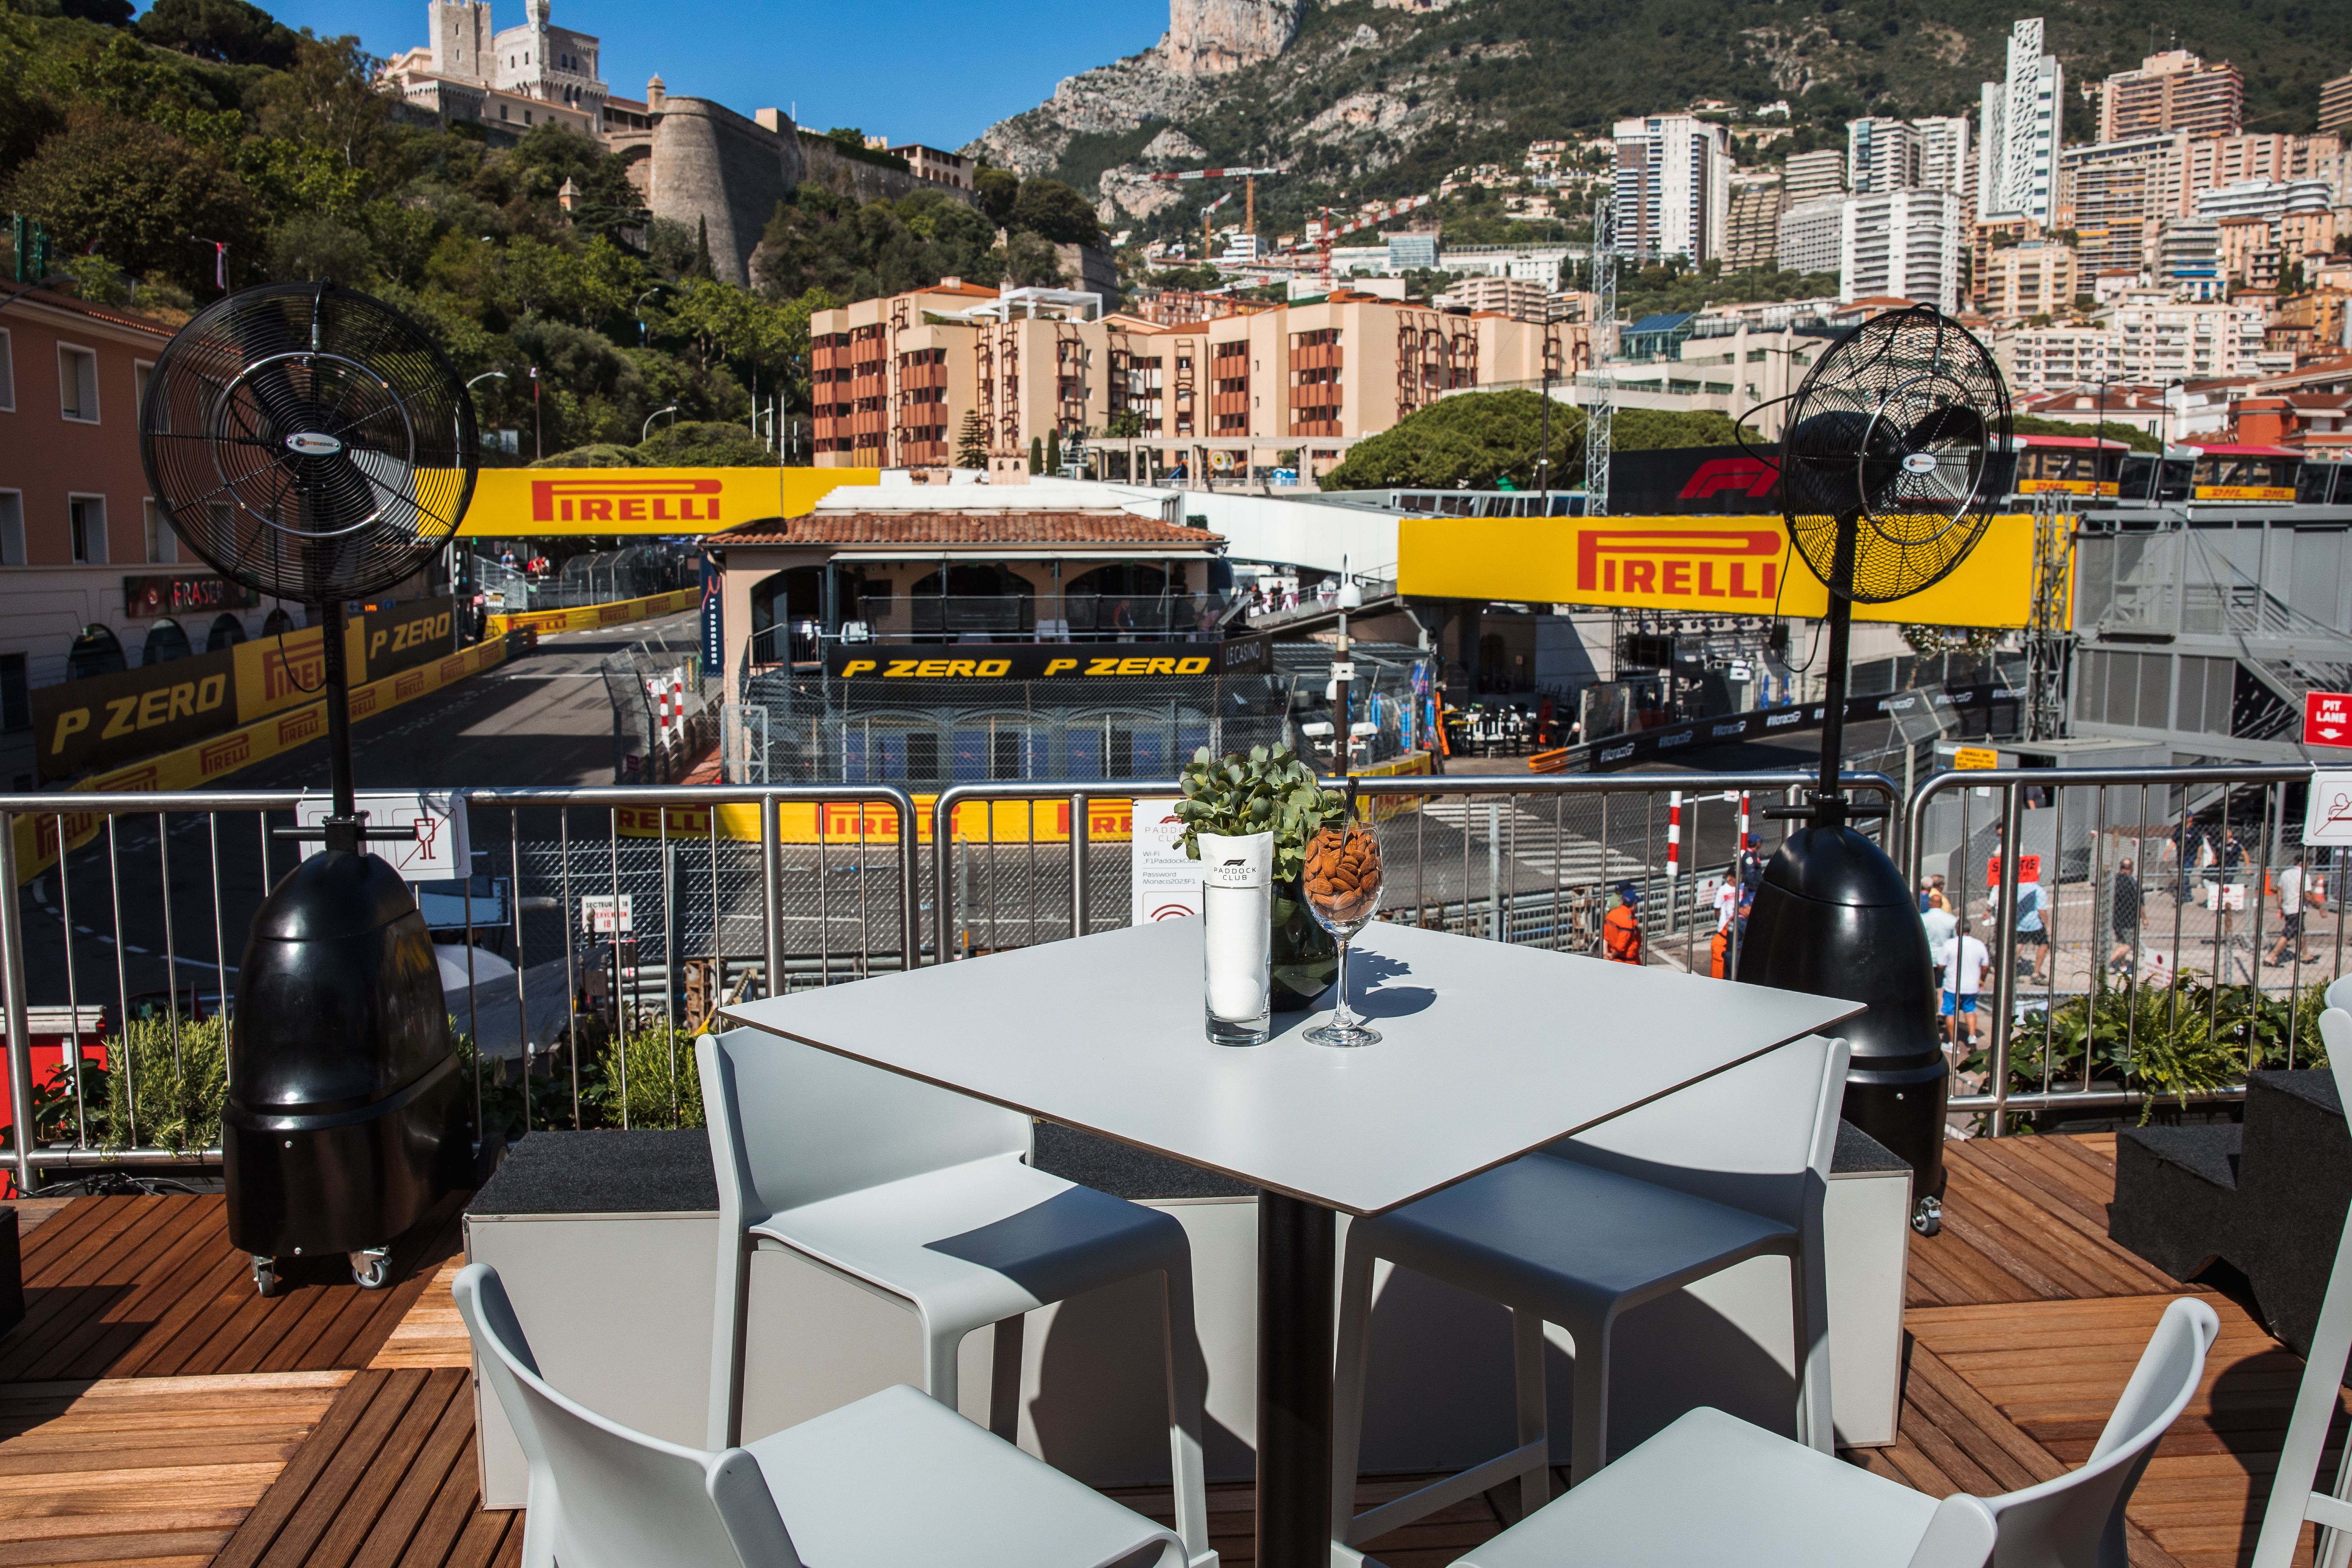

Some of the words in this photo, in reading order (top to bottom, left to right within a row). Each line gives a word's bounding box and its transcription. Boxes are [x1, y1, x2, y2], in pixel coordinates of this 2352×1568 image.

[532, 479, 722, 521] PIRELLI
[1577, 530, 1781, 599] PIRELLI
[174, 581, 223, 606] FRASER
[370, 630, 388, 660] P
[391, 611, 450, 653] ZERO
[841, 660, 876, 677] P
[883, 660, 1012, 677] ZERO
[1044, 659, 1078, 676] P
[1084, 657, 1211, 675] ZERO
[51, 707, 90, 755] P
[101, 673, 226, 740] ZERO
[2316, 711, 2347, 724] LANE
[2322, 700, 2342, 711] PIT
[278, 709, 318, 746] PIRELLI
[200, 733, 250, 775] PIRELLI
